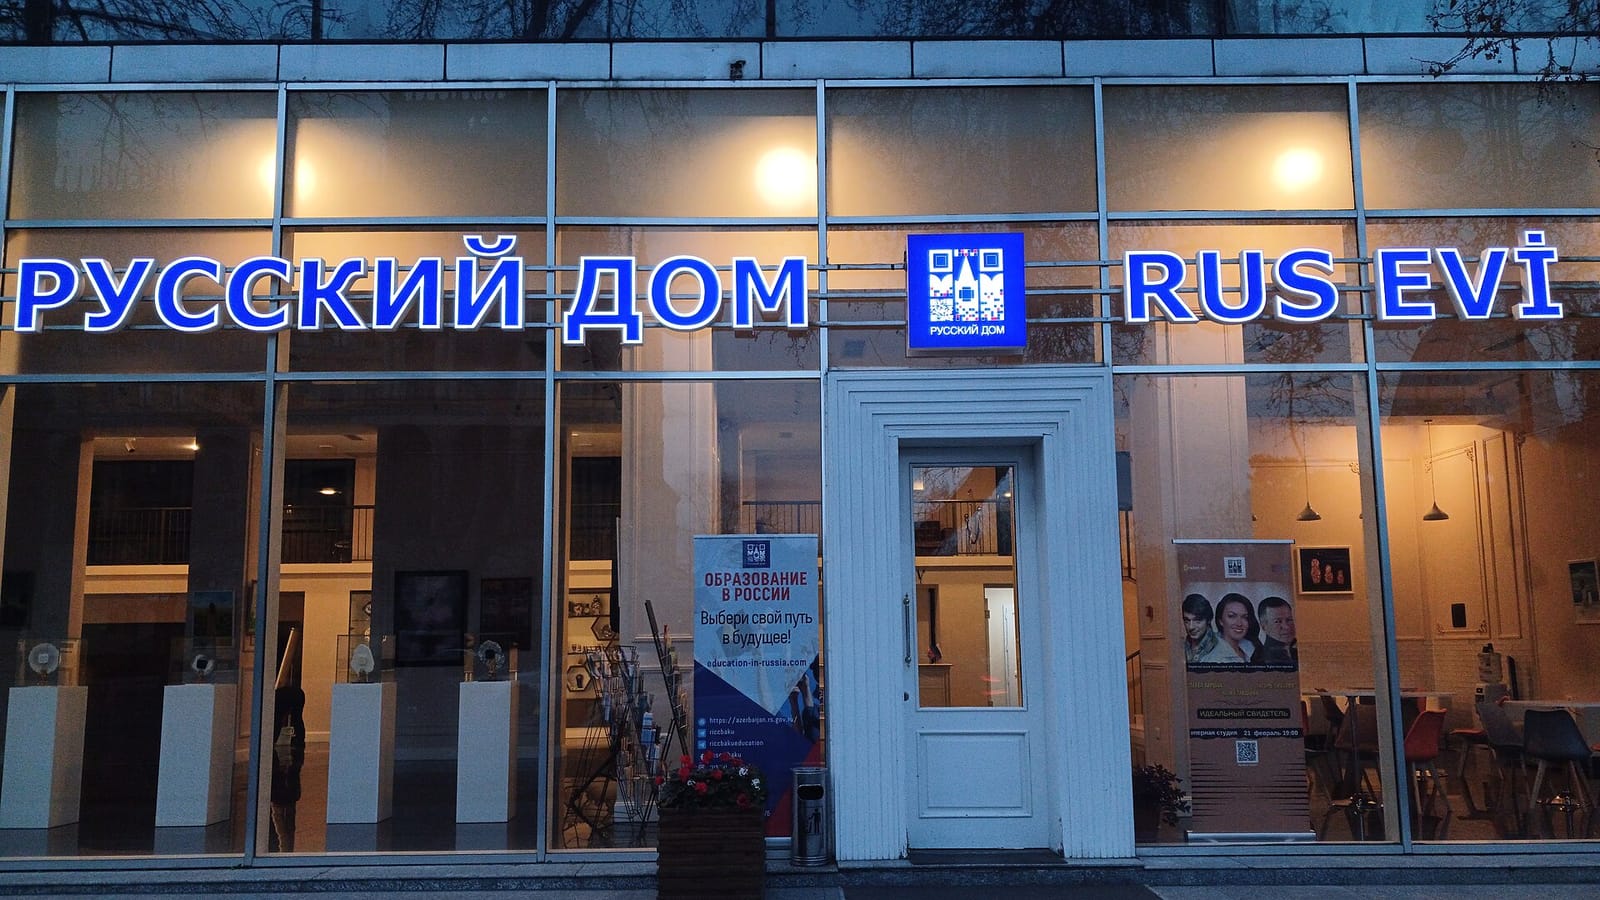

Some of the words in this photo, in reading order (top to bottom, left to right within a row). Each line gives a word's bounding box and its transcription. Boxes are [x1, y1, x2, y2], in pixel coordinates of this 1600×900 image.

[1122, 248, 1340, 324] RUS
[1375, 230, 1564, 320] EVİ
[14, 235, 526, 333] РУССКИЙ
[563, 255, 809, 344] ДОМ
[930, 325, 979, 335] РУССКИЙ
[981, 325, 1006, 336] ДОМ
[705, 572, 807, 586] ОБРАЗОВАНИЕ
[722, 588, 730, 601] В
[735, 587, 790, 601] РОССИИ
[701, 609, 749, 629] Выбери
[752, 610, 782, 624] свой
[784, 613, 813, 629] путь
[722, 633, 730, 645] в
[733, 630, 791, 648] будущее!
[707, 658, 807, 667] education-in-russia.com
[1200, 710, 1245, 718] ИДЕАЛЬНЫЙ
